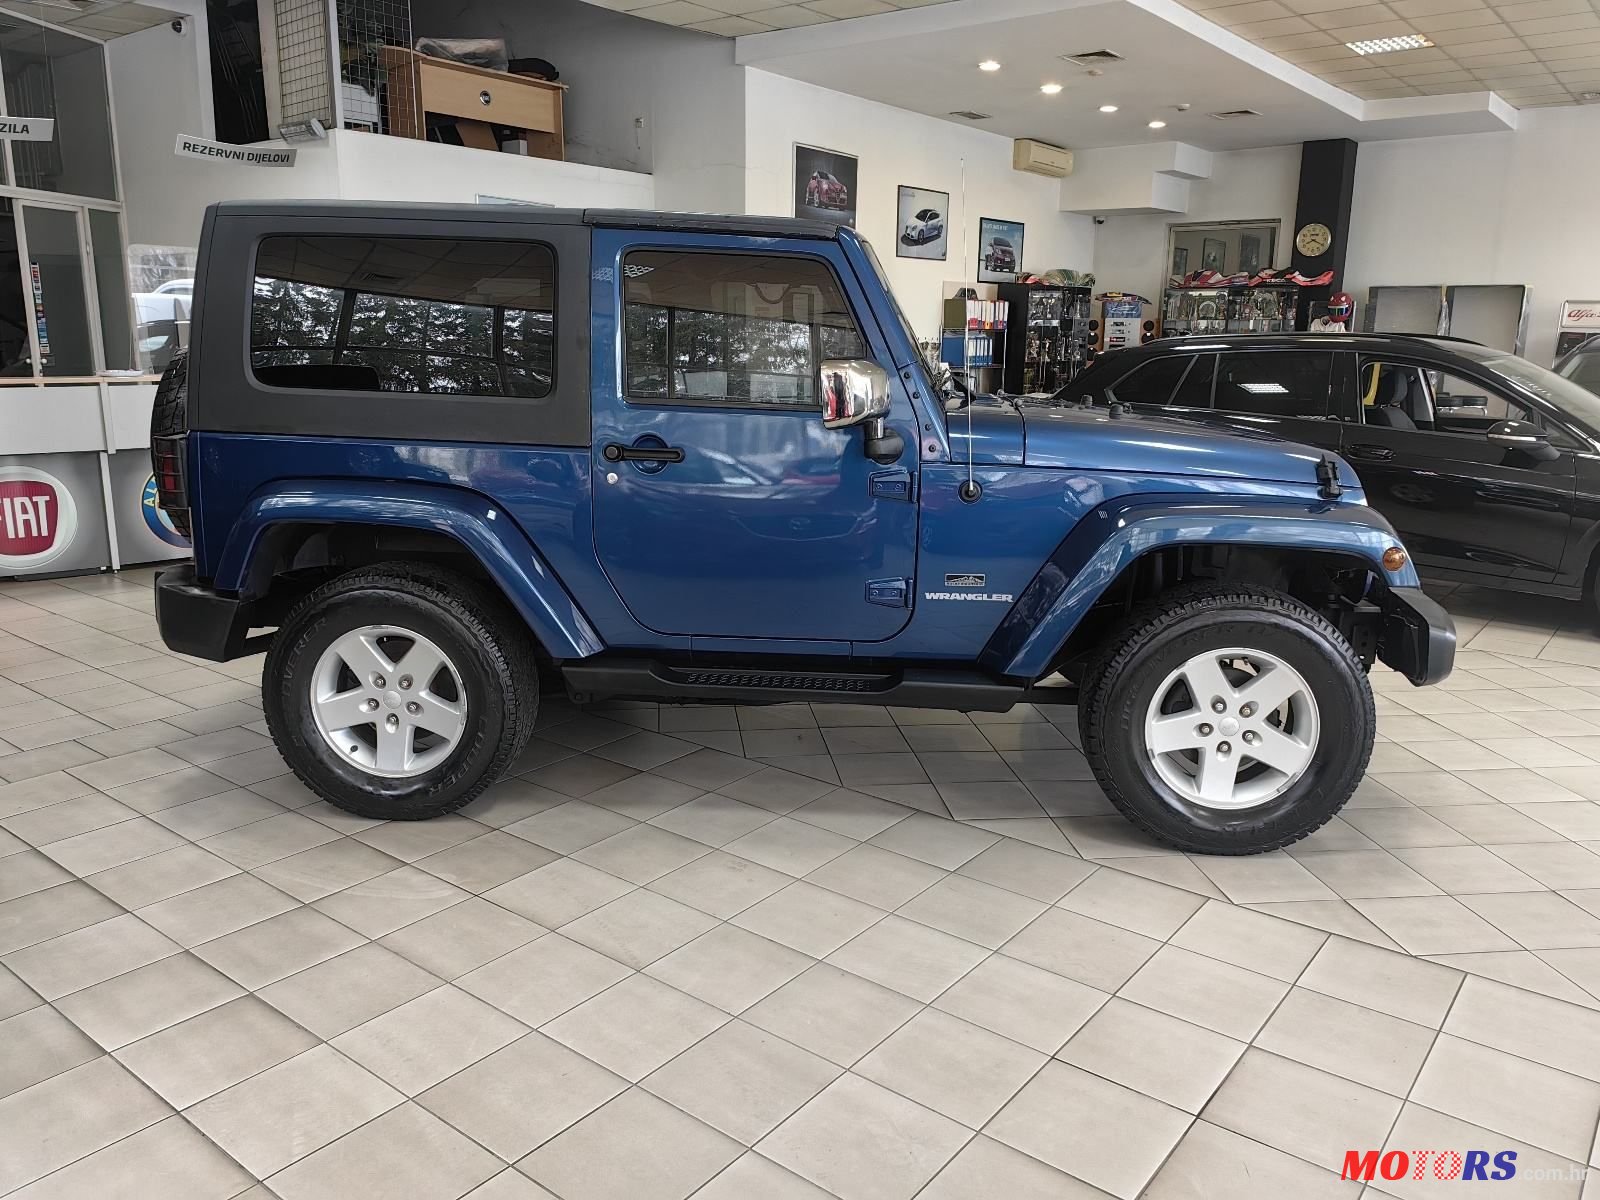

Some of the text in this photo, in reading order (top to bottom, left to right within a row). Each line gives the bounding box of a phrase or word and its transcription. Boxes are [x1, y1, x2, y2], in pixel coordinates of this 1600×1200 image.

[182, 141, 290, 164] REZERVNI DIJELOVI
[0, 495, 50, 539] IAT
[924, 592, 1014, 603] WRANGLER
